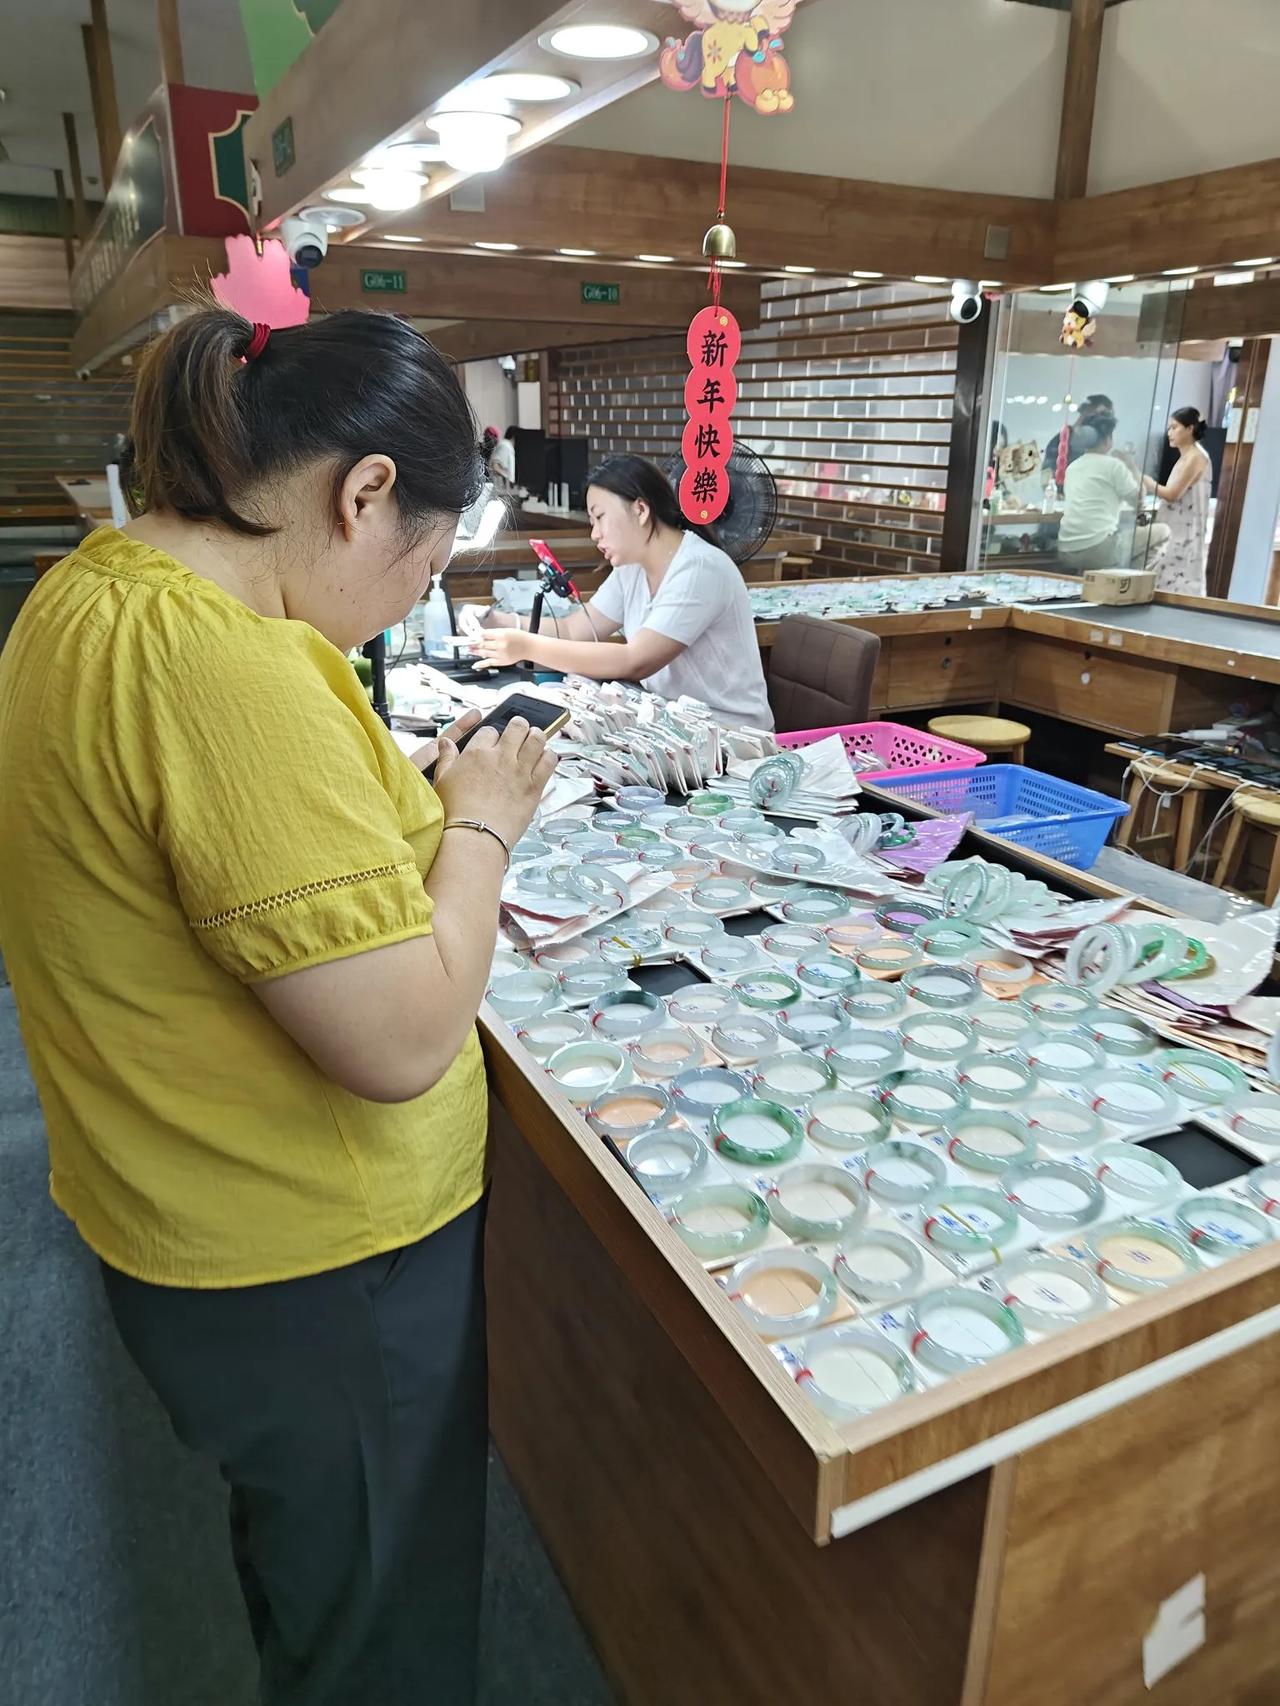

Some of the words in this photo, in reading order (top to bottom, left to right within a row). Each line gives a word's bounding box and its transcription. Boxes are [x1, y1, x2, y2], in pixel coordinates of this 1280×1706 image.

[364, 272, 404, 289] G06-11
[583, 285, 617, 300] G06-10
[691, 330, 729, 503] 新年快樂
